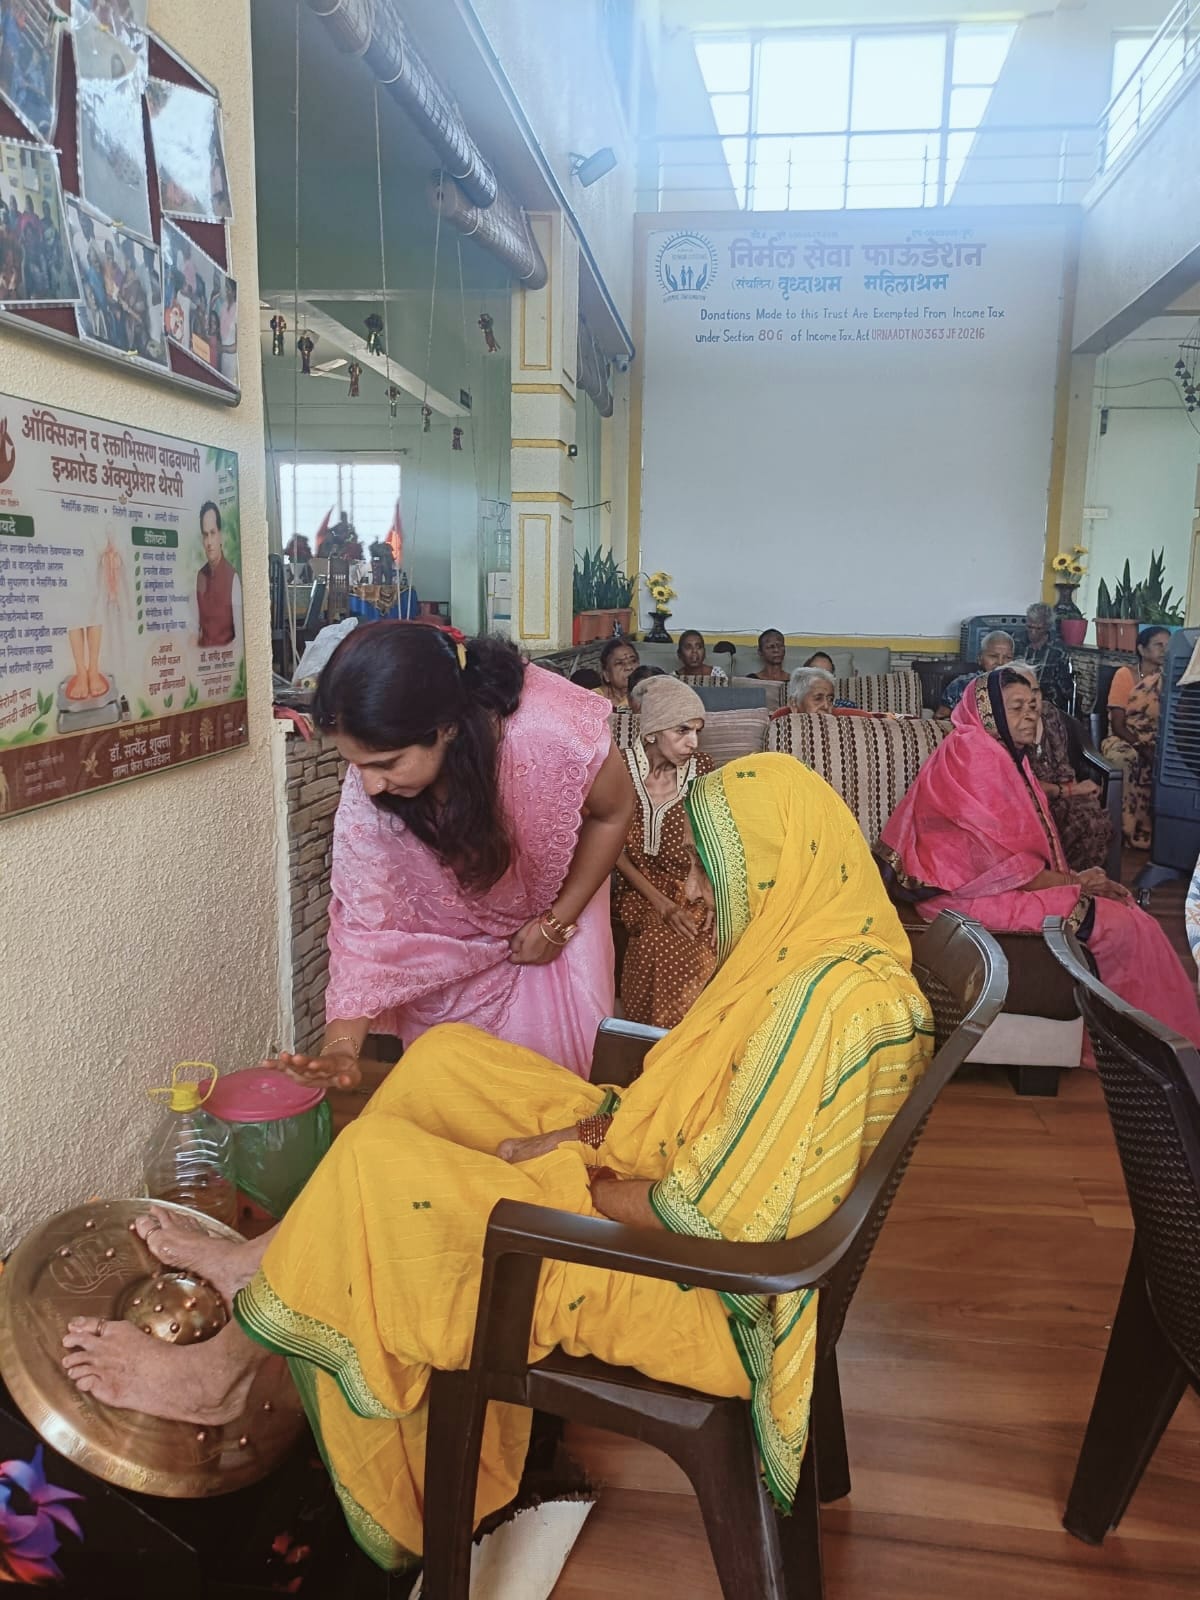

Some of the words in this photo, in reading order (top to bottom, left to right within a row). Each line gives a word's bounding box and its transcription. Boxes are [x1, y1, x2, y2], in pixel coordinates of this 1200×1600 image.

[728, 237, 798, 269] निर्मल
[804, 239, 854, 269] सेवा
[861, 237, 986, 268] फाऊंडेशन
[863, 269, 949, 296] महिलाश्रम
[700, 308, 751, 321] Donations
[756, 308, 782, 320] Made
[784, 309, 796, 320] to
[801, 307, 818, 319] this
[823, 307, 848, 319] Trust
[853, 307, 868, 319] Are
[873, 307, 919, 320] Exempted
[923, 306, 946, 319] From
[953, 306, 985, 319] Income
[988, 306, 1005, 318] Tax
[695, 330, 720, 343] under
[723, 329, 754, 342] Section
[790, 330, 802, 341] of
[806, 329, 836, 342] Income
[856, 329, 870, 341] Act
[22, 408, 87, 451] ऑक्सिजन
[90, 430, 99, 453] व
[102, 430, 156, 464] रक्ताभिसरण
[158, 447, 200, 474] वाढवणारी
[51, 452, 97, 484] इन्फ्रारेड
[159, 469, 184, 498] थेरपी
[109, 743, 122, 762] डॉ.
